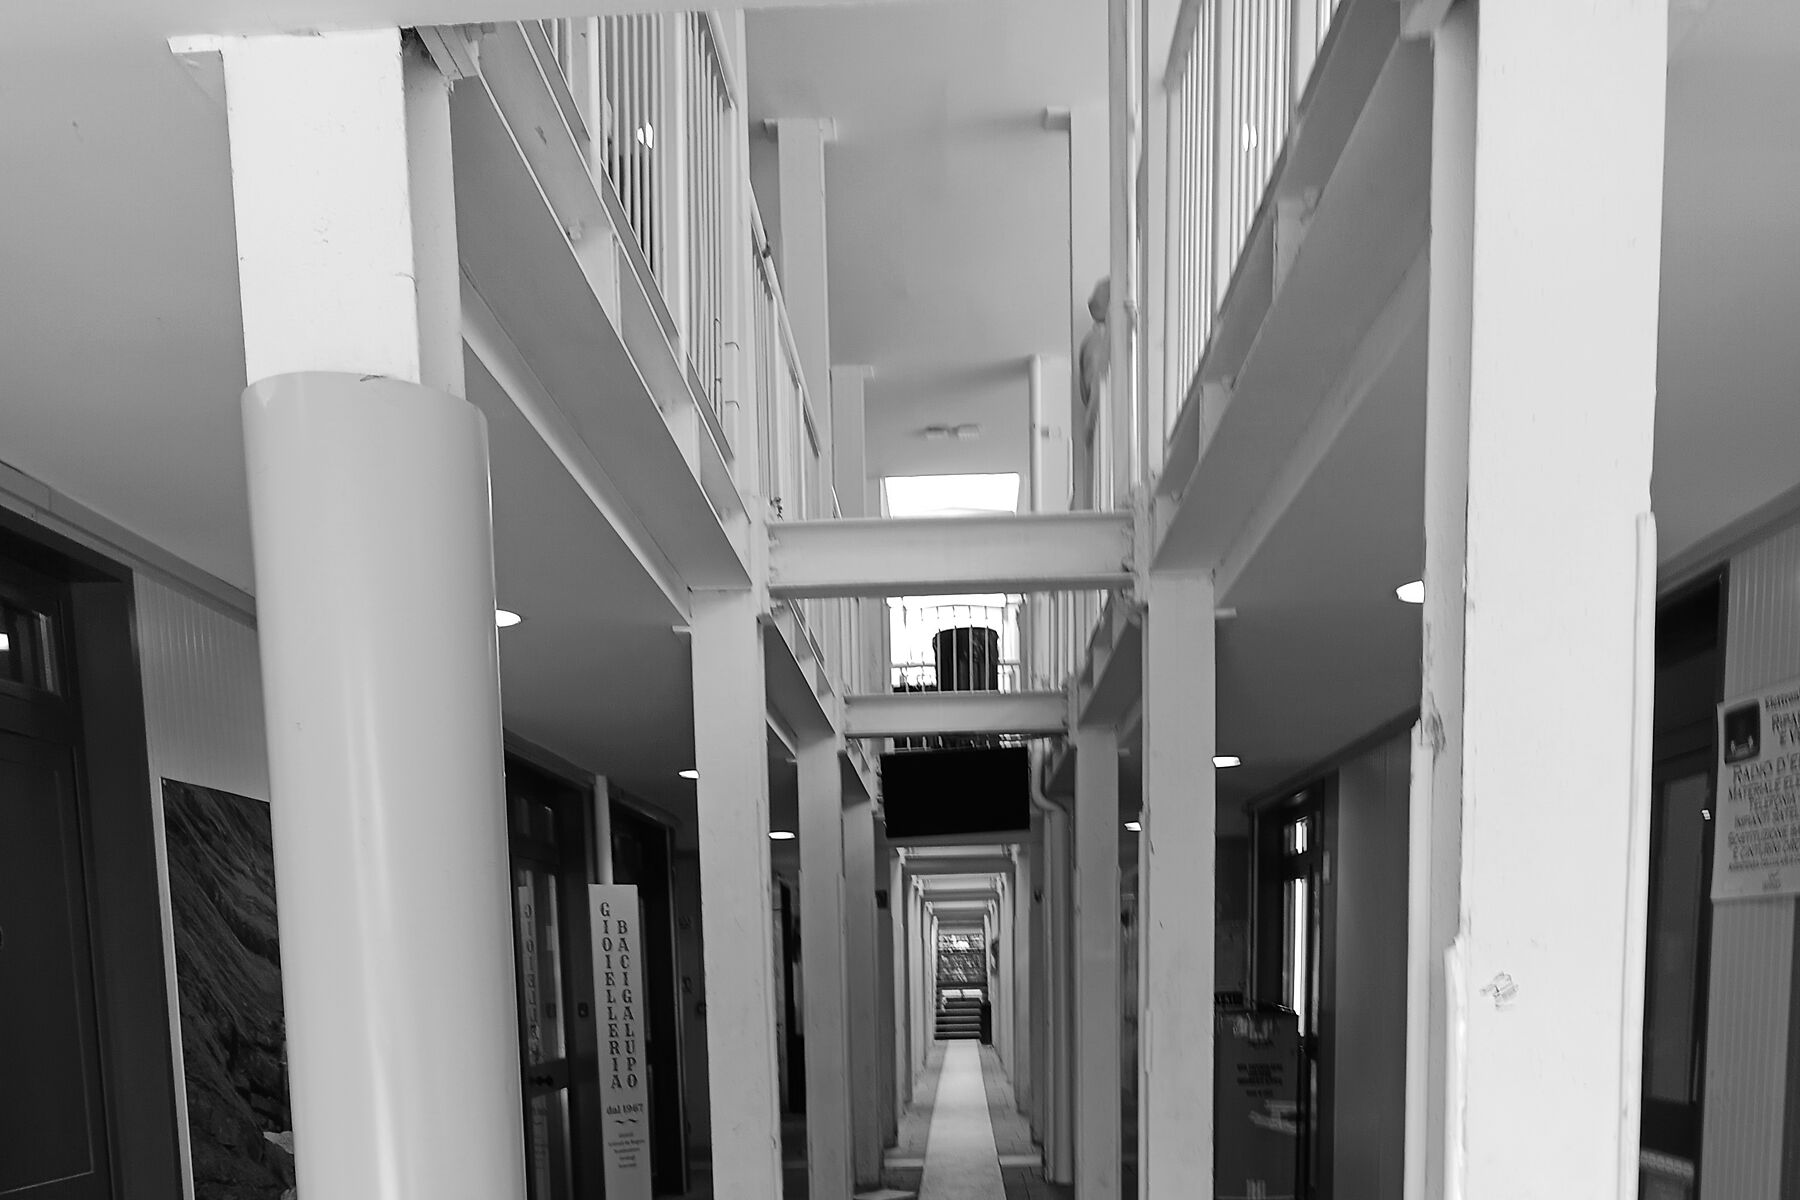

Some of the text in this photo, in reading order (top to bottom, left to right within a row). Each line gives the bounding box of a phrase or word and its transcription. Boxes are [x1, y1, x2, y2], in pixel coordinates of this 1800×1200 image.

[1733, 760, 1773, 787] RADIO
[1728, 776, 1782, 801] MATERIALE
[600, 902, 622, 1089] GIOIELLERIA
[617, 919, 638, 1089] BACIGALUPO
[606, 1104, 621, 1115] dal
